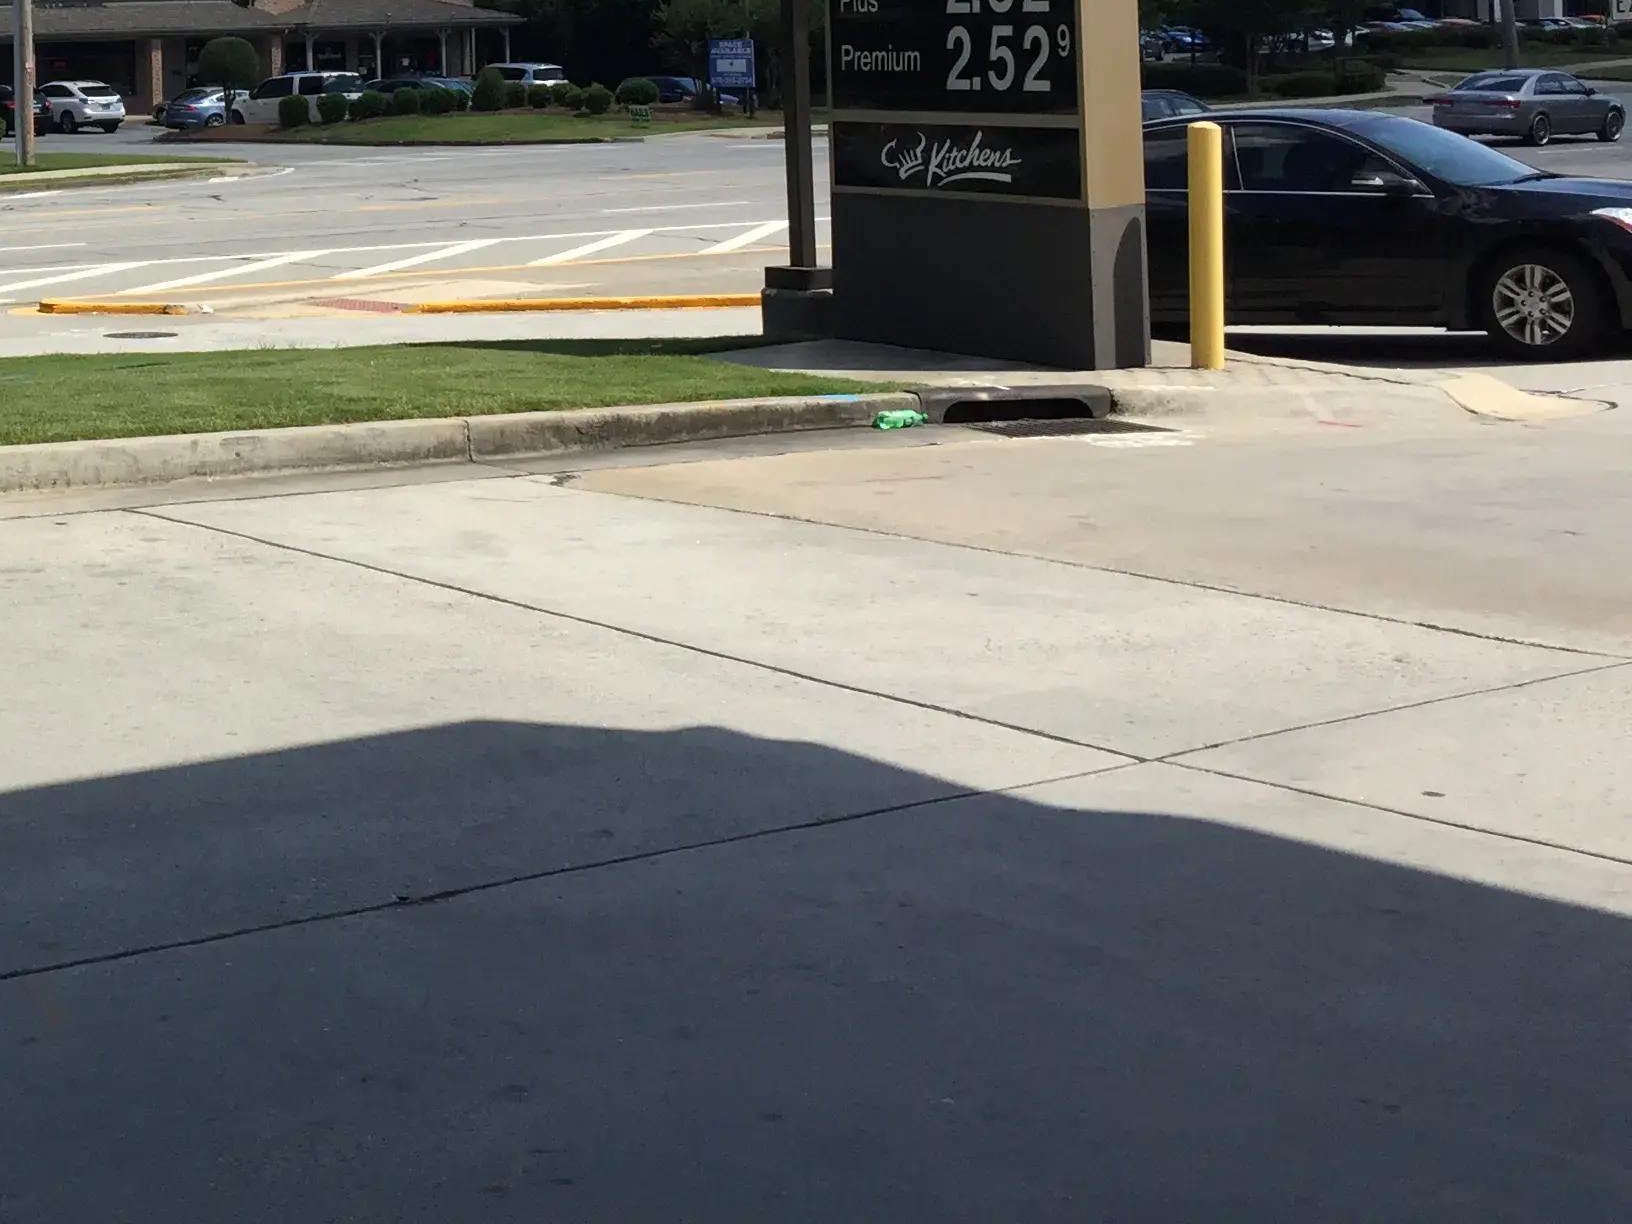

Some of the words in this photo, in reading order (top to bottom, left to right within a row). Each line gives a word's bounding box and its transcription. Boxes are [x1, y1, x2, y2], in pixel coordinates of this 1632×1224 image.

[841, 44, 921, 72] Premium
[946, 25, 1051, 92] 2.52
[927, 130, 1023, 187] Kitchens
